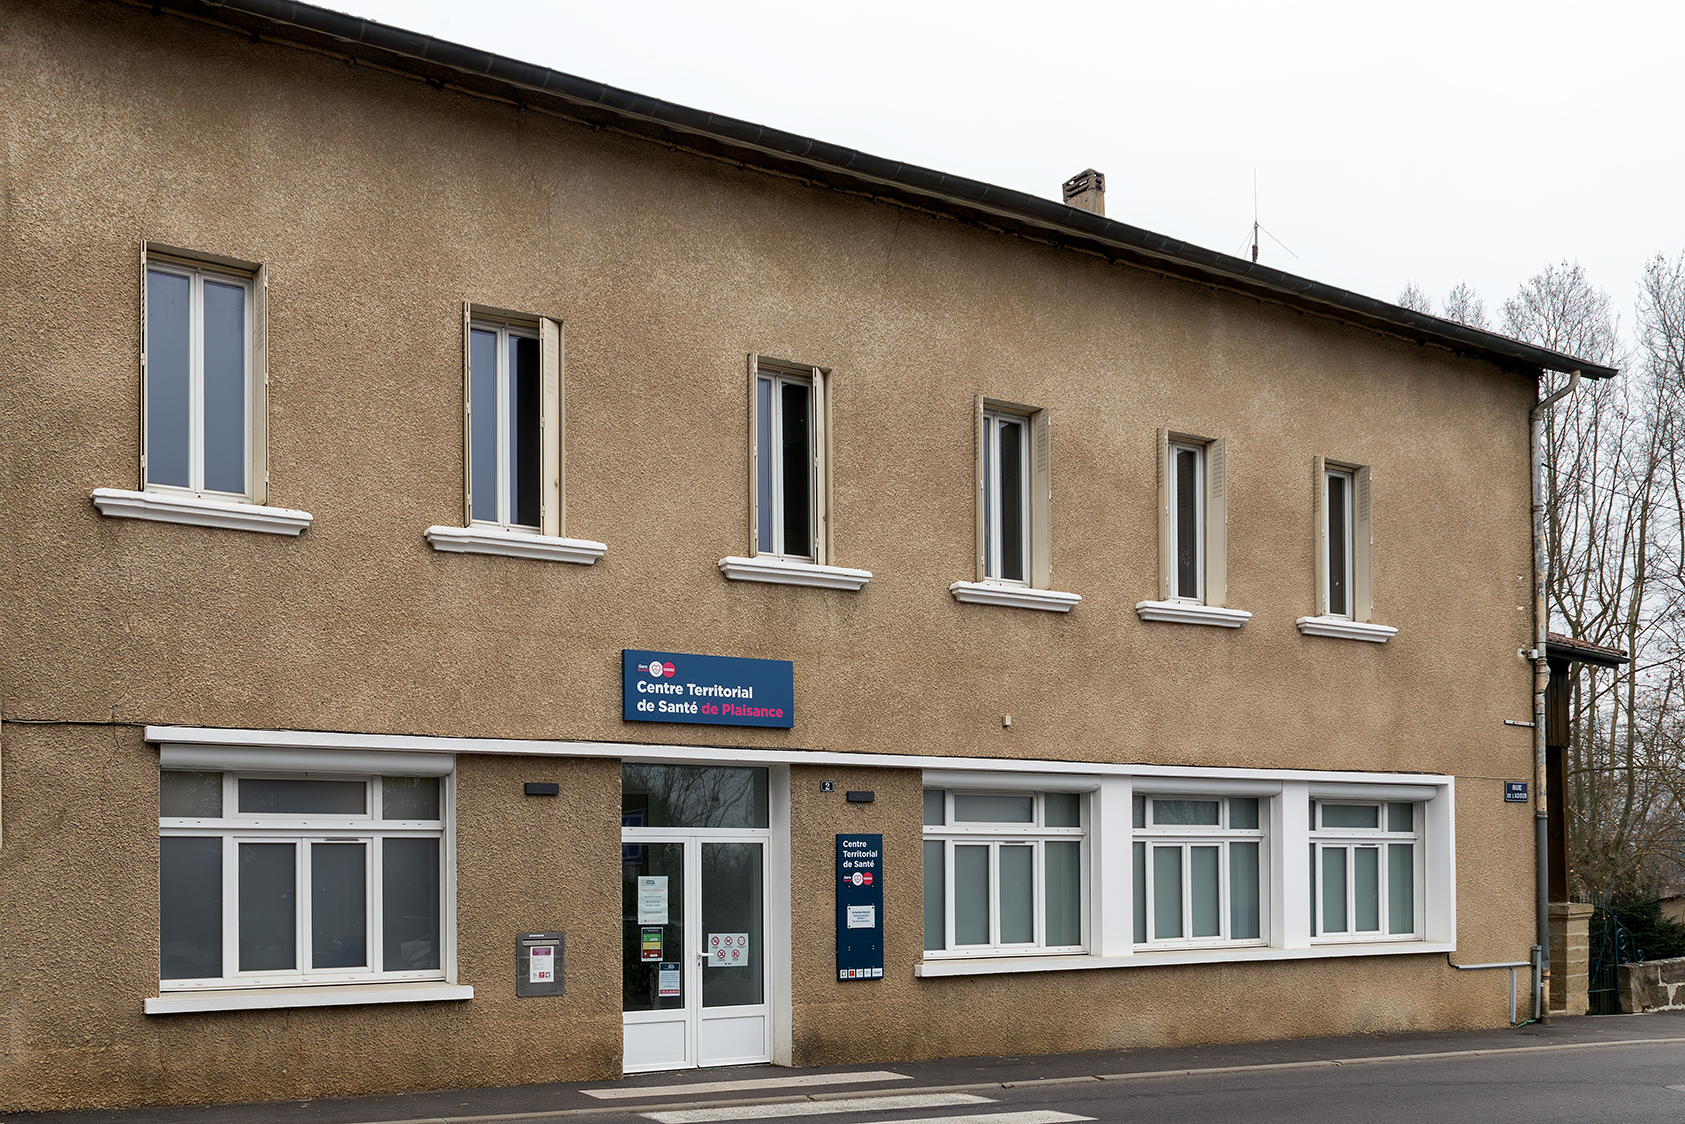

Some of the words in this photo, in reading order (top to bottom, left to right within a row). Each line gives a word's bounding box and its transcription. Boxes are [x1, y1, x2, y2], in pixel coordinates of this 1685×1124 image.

[637, 680, 683, 695] Centre
[687, 683, 753, 699] Territorial
[637, 699, 654, 712] de
[658, 700, 698, 714] Santé
[701, 702, 719, 715] de
[722, 703, 784, 718] Plaisance
[825, 782, 830, 791] 2
[843, 840, 867, 848] Centre
[843, 850, 878, 858] Territorial
[843, 860, 852, 868] de
[854, 860, 875, 868] Santé
